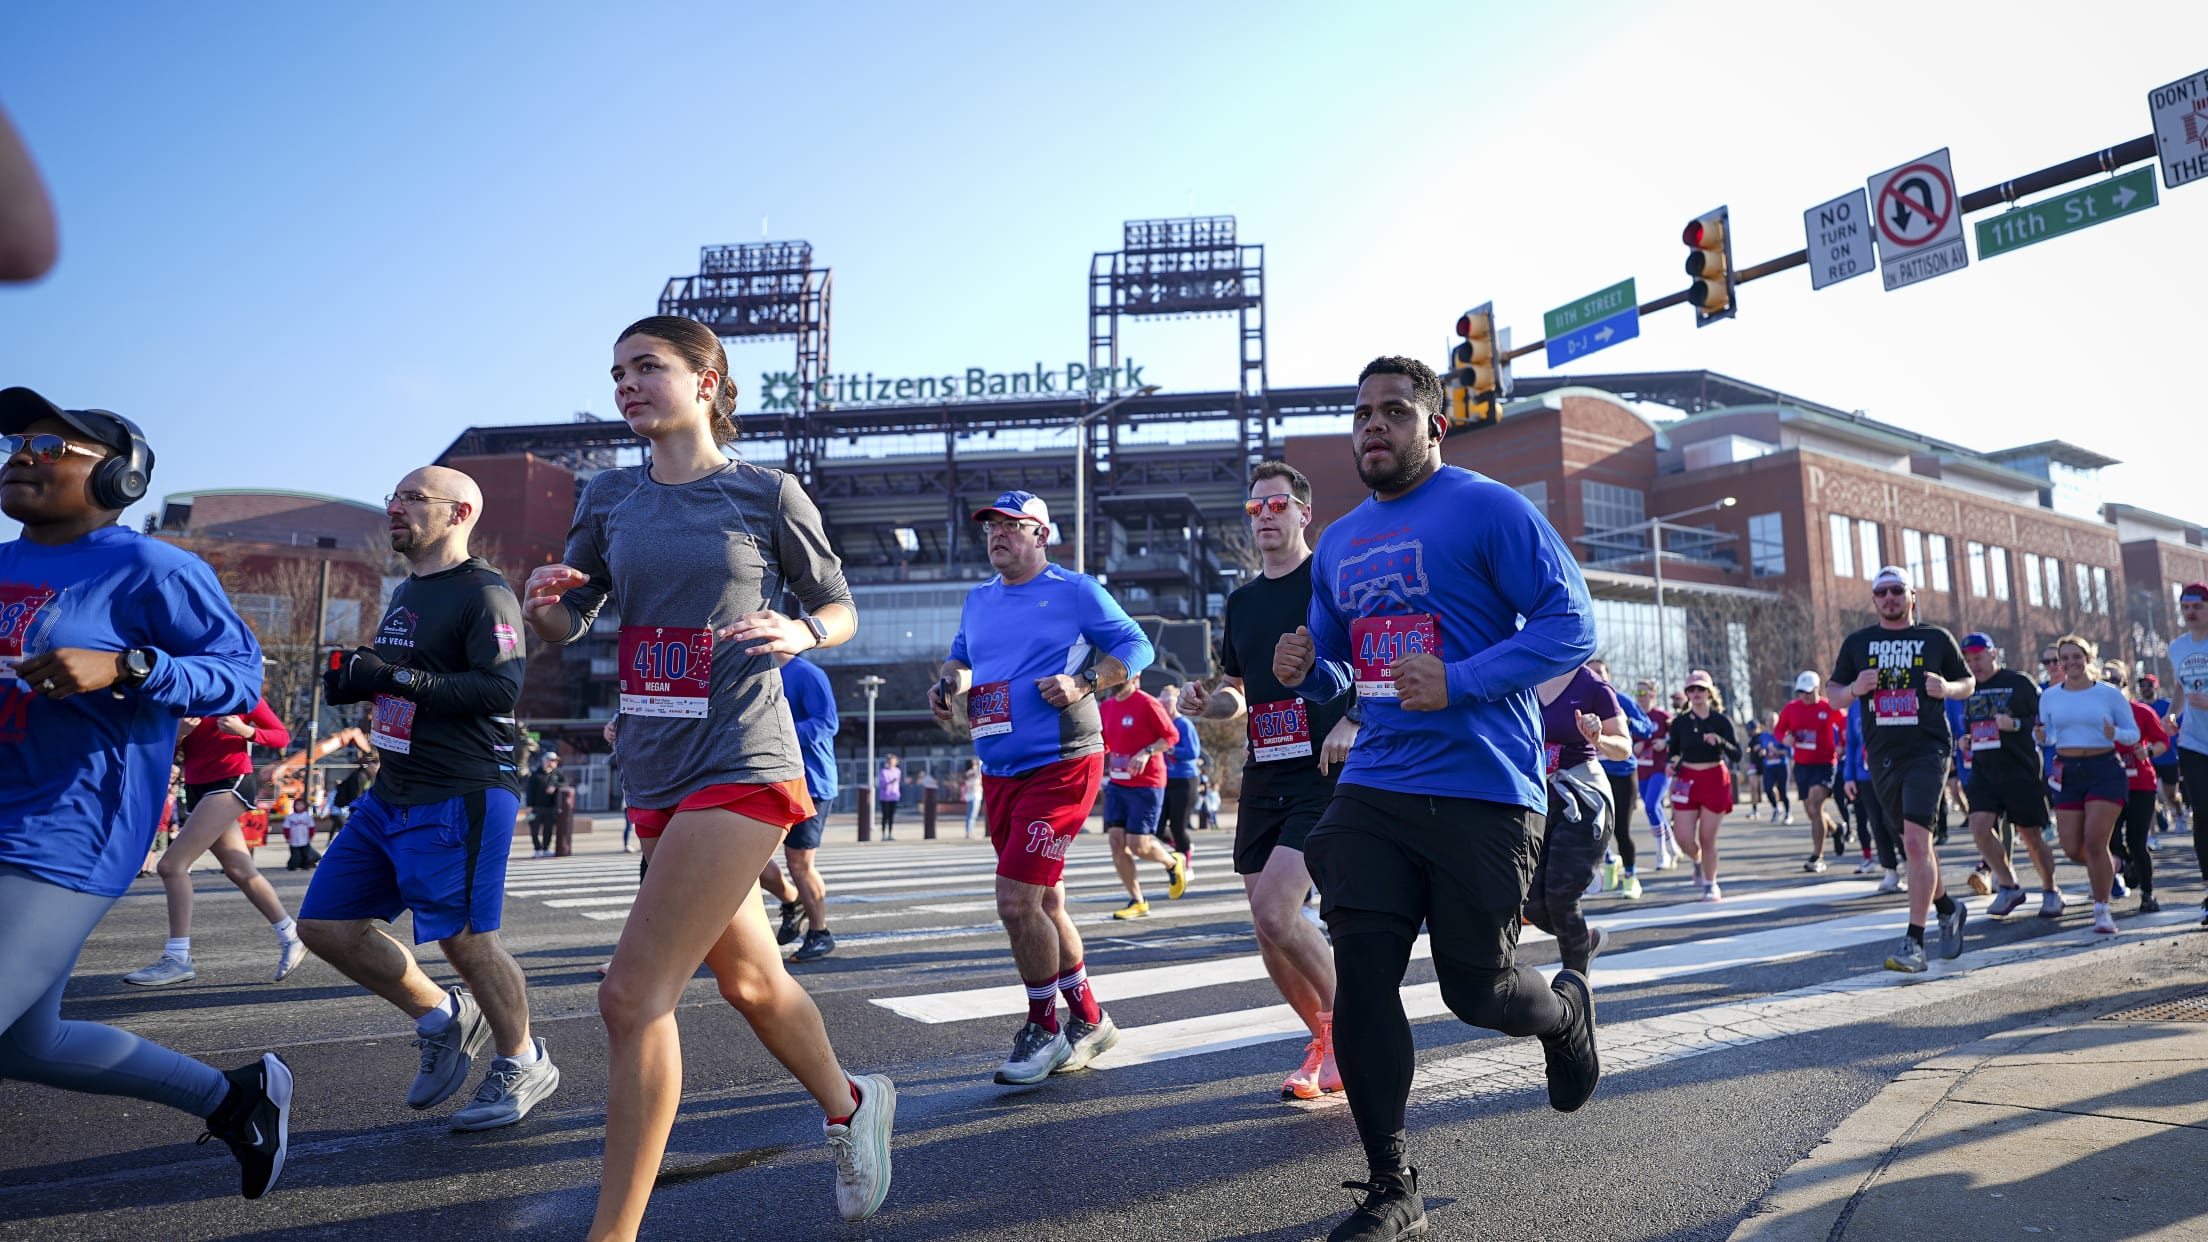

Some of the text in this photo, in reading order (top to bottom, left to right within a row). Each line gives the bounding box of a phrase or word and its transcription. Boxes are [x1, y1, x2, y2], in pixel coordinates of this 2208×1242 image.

[2169, 155, 2208, 182] THE
[1821, 203, 1850, 229] NO
[1992, 194, 2098, 247] 11th St
[1820, 222, 1857, 247] TURN
[1831, 243, 1850, 260] ON
[1829, 260, 1856, 281] RED
[1900, 253, 1949, 283] PATTISON
[1555, 289, 1623, 329] 11TH STREET
[1568, 335, 1588, 355] D-J
[814, 357, 1145, 403] Citizens Bank Park
[389, 637, 415, 648] VEGAS
[1360, 631, 1424, 666] 4416
[1868, 640, 1925, 656] ROCKY
[633, 641, 687, 680] 410
[1879, 655, 1913, 669] RUN
[645, 681, 670, 692] MEGAN
[375, 695, 410, 728] 3877
[1255, 708, 1298, 737] 1379
